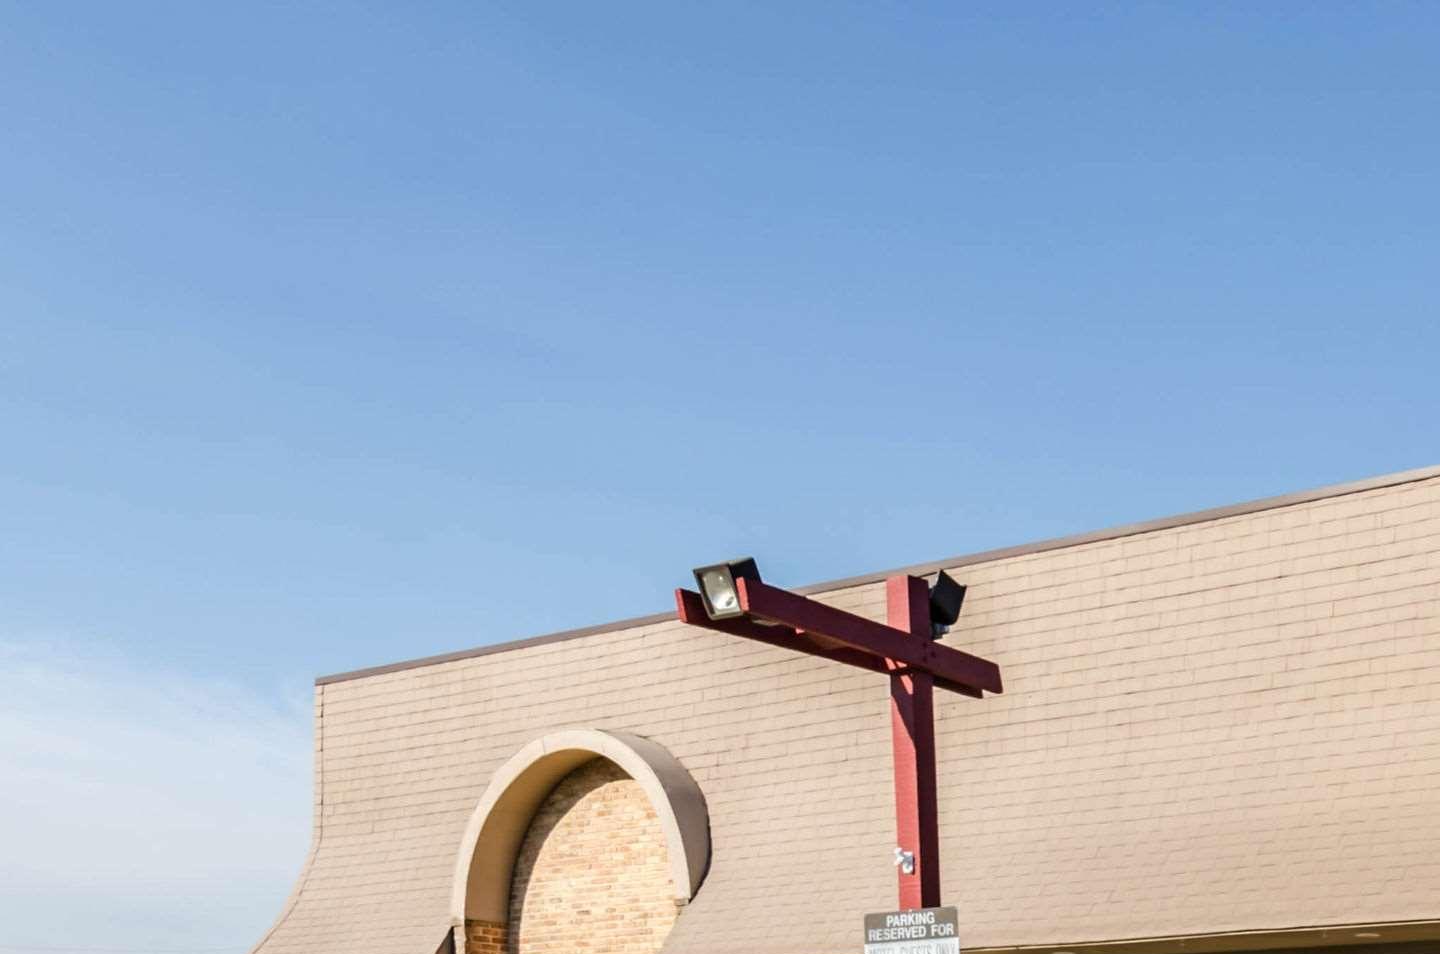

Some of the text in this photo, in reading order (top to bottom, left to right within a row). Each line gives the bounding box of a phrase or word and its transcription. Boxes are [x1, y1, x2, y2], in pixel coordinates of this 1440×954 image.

[886, 911, 935, 928] PARKING
[868, 923, 954, 942] RESERVED FOR
